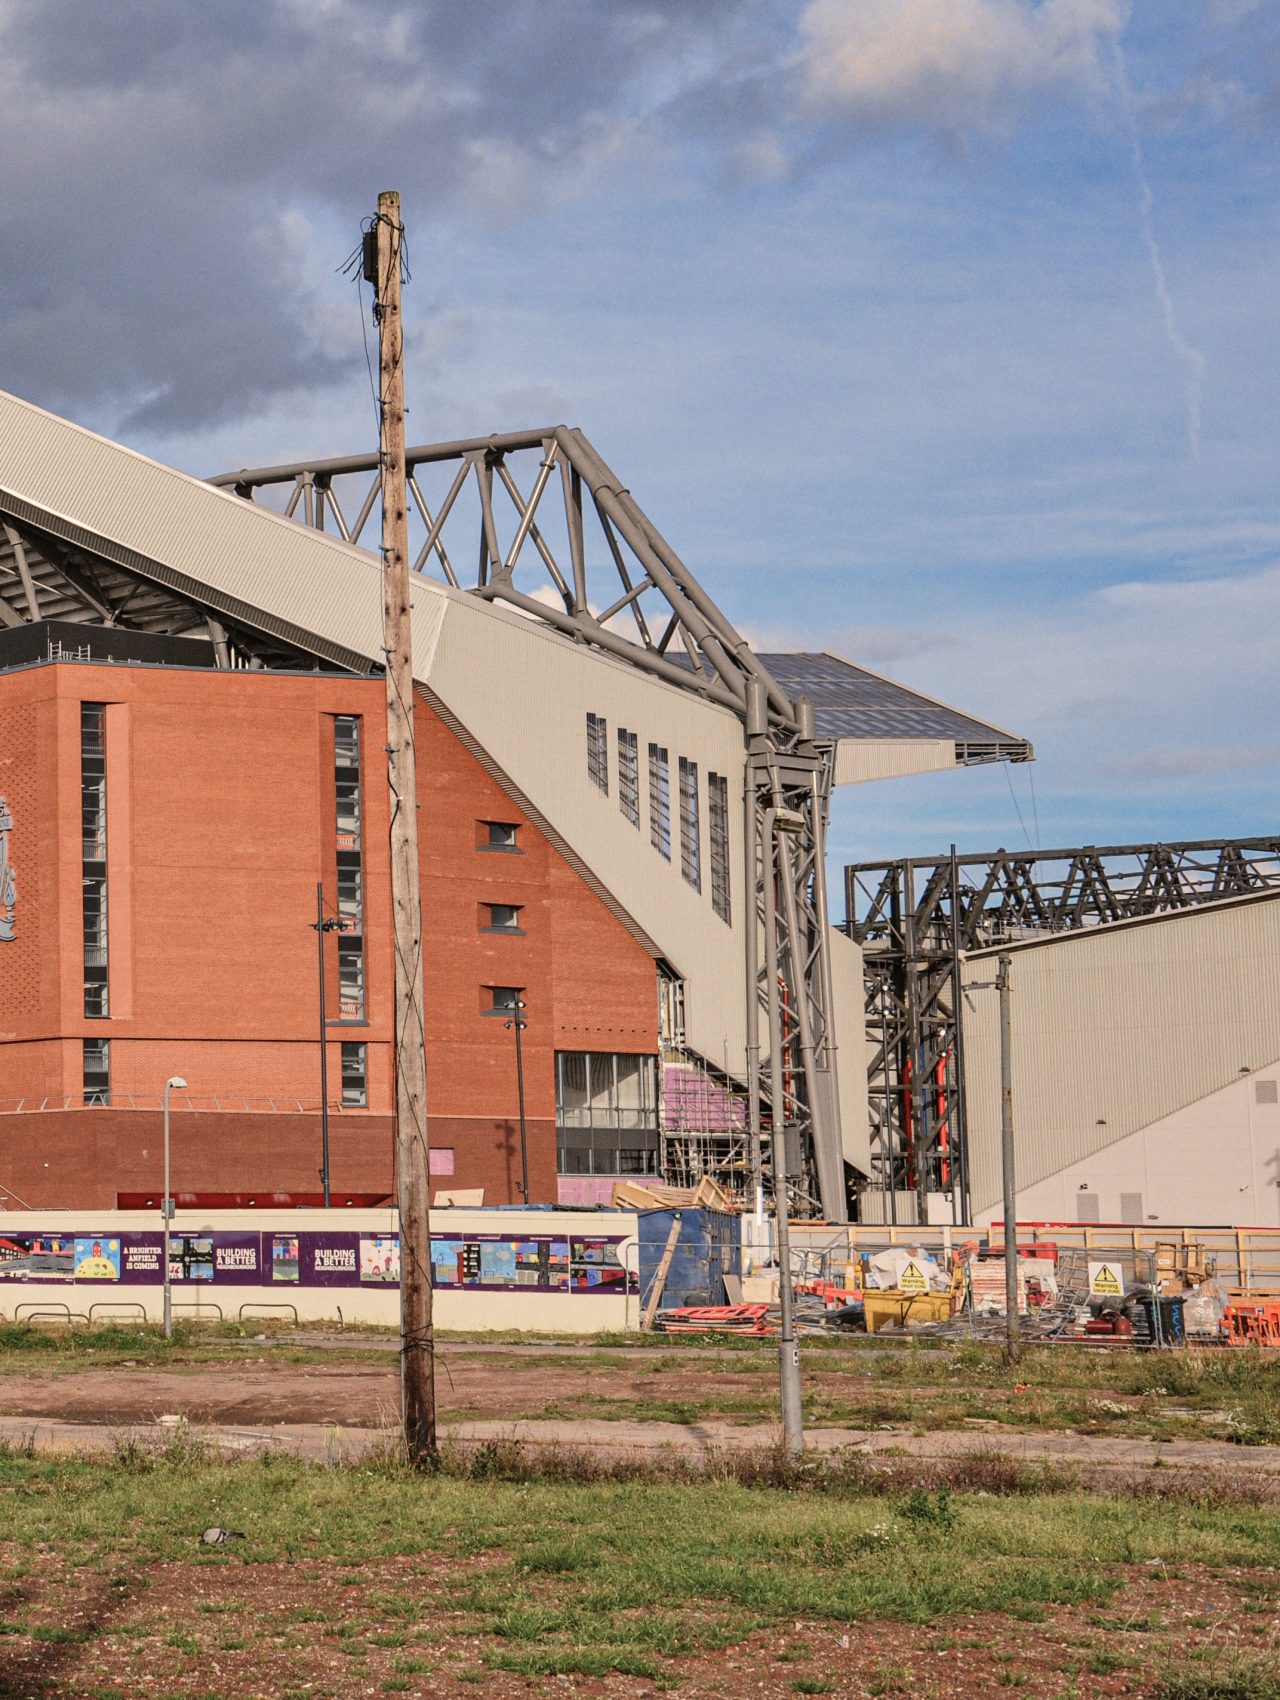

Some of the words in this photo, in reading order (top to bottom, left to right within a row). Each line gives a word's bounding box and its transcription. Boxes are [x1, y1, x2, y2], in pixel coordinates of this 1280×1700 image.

[216, 1248, 256, 1256] BUILDING
[315, 1249, 355, 1258] BUILDING
[216, 1256, 223, 1265] A
[225, 1256, 256, 1265] BETTER
[315, 1257, 322, 1266] A
[324, 1257, 355, 1266] BETTER
[133, 1262, 159, 1270] COMING
